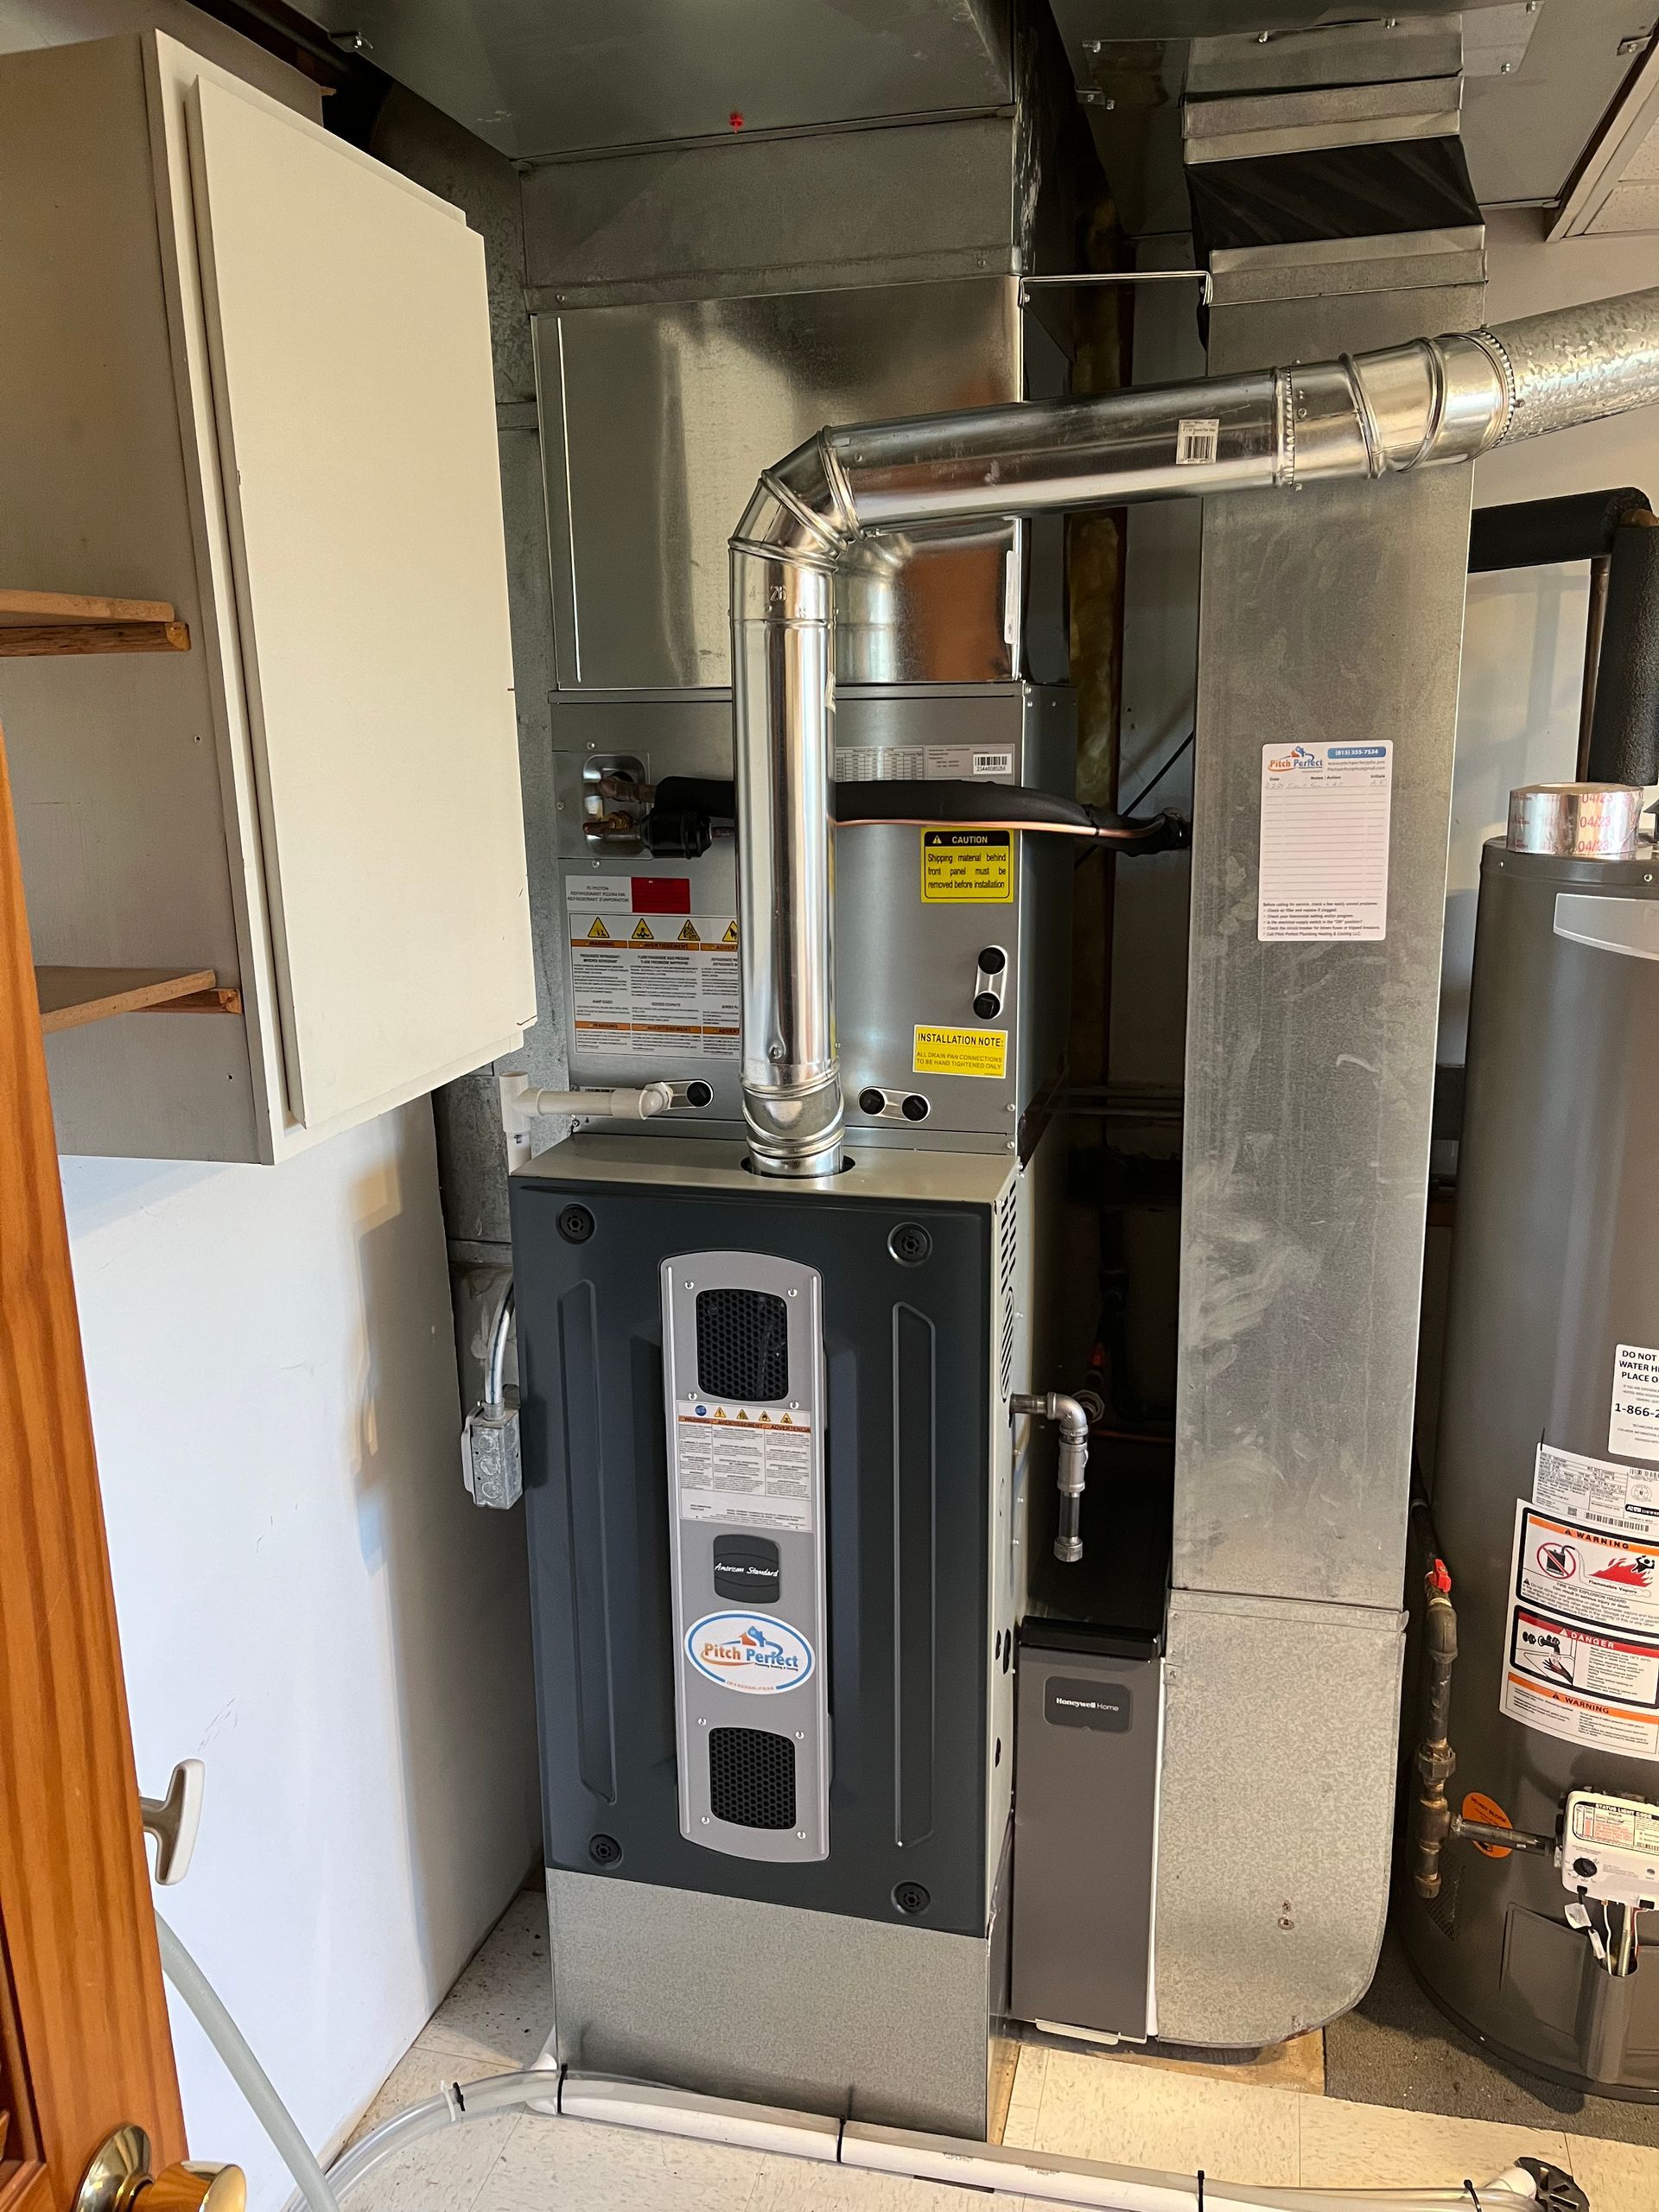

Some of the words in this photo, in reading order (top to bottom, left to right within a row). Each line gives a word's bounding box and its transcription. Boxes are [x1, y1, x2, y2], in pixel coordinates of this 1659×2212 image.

[1294, 759, 1323, 767] Perfect
[1582, 793, 1613, 804] 04/23
[1580, 817, 1611, 828] 04/23
[951, 836, 988, 844] CAUTION
[1578, 841, 1610, 853] 04/23
[927, 853, 953, 864] Shipping
[957, 853, 982, 861] material
[986, 853, 1006, 861] behind
[928, 867, 941, 875] front
[950, 867, 966, 877] panel
[975, 867, 989, 875] must
[998, 867, 1006, 875] be
[954, 880, 973, 888] before
[974, 880, 1004, 888] installation
[918, 1033, 976, 1046] INSTALLATION
[978, 1037, 1004, 1047] NOTE:
[951, 1060, 984, 1069] TIGHTENED
[959, 1054, 1002, 1064] CONNECTIONS
[1622, 1350, 1636, 1358] DO
[1637, 1352, 1657, 1362] NOT
[1618, 1360, 1649, 1371] WATER
[1621, 1371, 1649, 1382] PLACE
[1576, 1530, 1629, 1550] WARNING
[715, 1562, 744, 1573] American
[747, 1567, 779, 1578] Standard
[1588, 1580, 1617, 1590] Flammable
[1571, 1632, 1614, 1649] DANGER
[704, 1643, 741, 1661] Pitch
[746, 1648, 798, 1669] Perfect
[1056, 1697, 1096, 1709] Honeywell
[1096, 1703, 1119, 1712] Home
[1565, 1696, 1610, 1714] WARNING
[1595, 1803, 1617, 1813] STATUS
